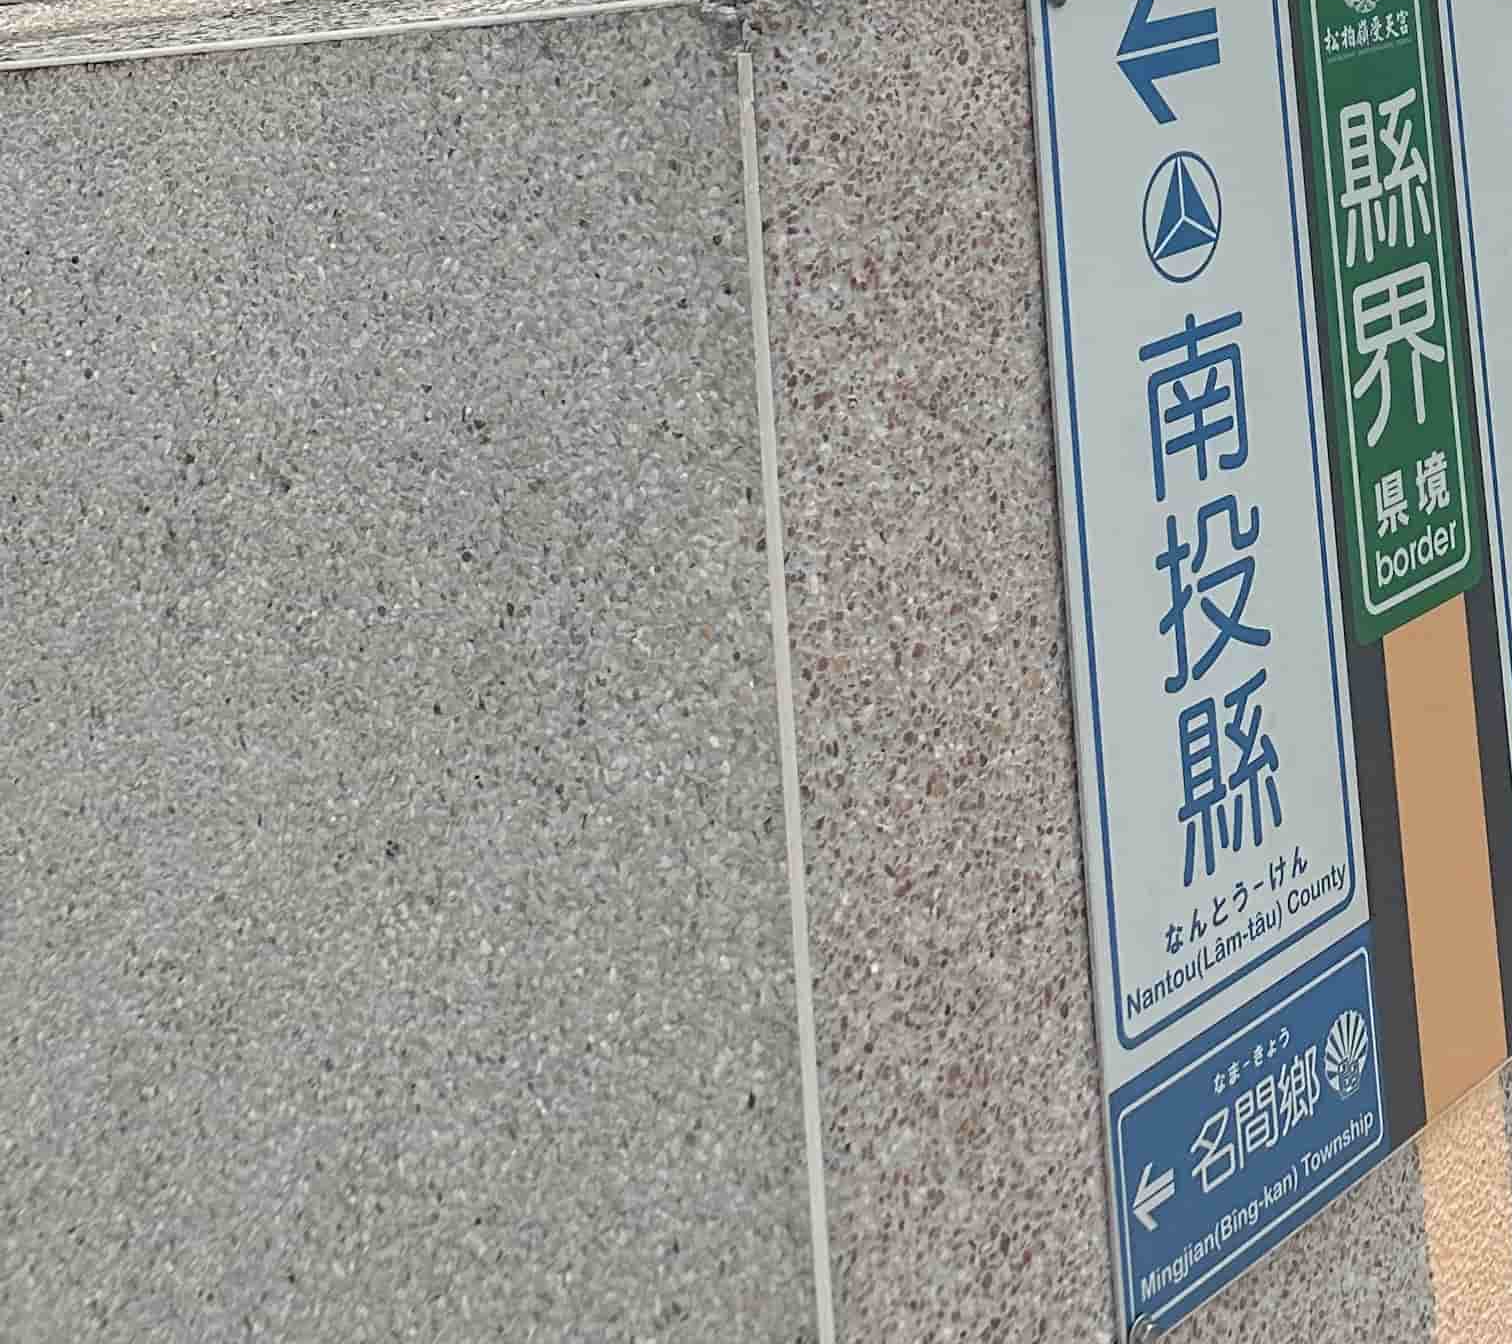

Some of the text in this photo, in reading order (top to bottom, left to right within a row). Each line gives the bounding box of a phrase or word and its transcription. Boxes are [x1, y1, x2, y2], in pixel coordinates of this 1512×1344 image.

[1339, 88, 1446, 448] 縣界
[1374, 449, 1451, 539] 県境
[1375, 519, 1457, 589] border
[1138, 312, 1284, 887] 南投縣
[1286, 862, 1347, 915] County
[1300, 1110, 1376, 1179] Township
